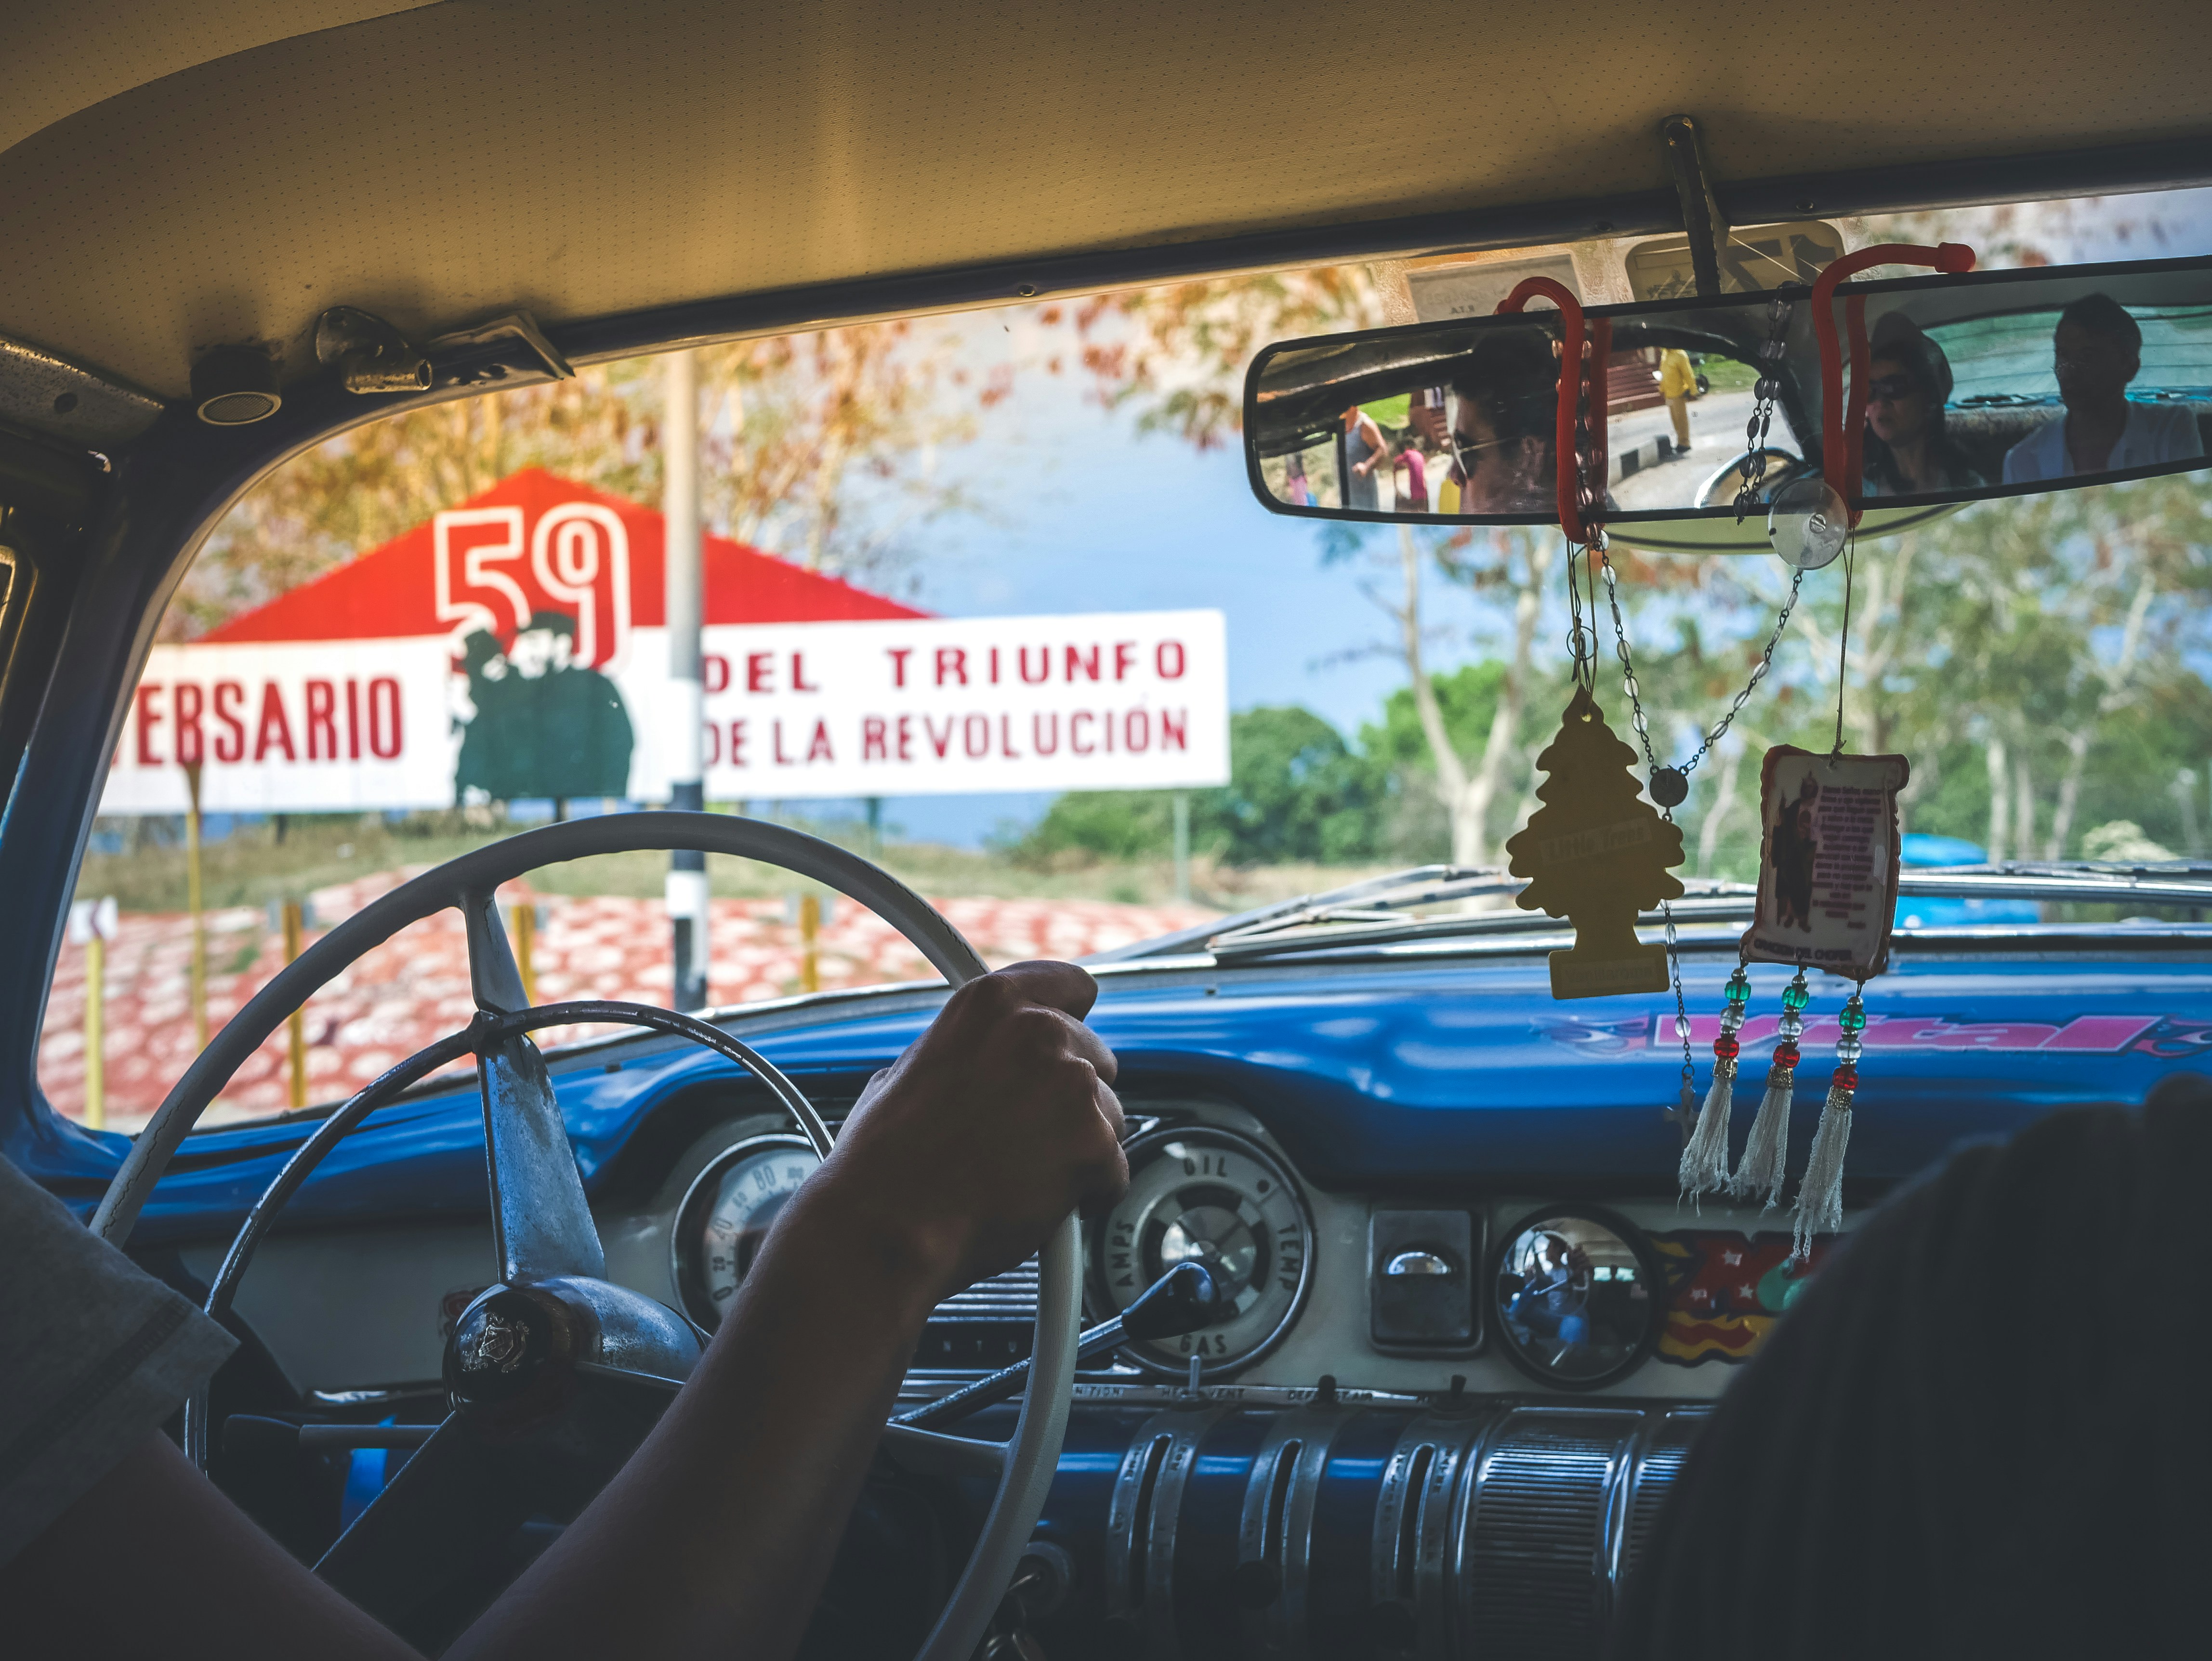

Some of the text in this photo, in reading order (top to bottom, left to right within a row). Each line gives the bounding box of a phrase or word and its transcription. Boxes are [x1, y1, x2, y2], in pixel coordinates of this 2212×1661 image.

[434, 502, 632, 675] 59
[704, 641, 1185, 695] DEL TRIUNFO
[111, 678, 404, 769] ERSARIO
[705, 720, 749, 767] DE
[774, 719, 835, 764] LA
[1183, 1156, 1228, 1177] OIL
[1112, 1220, 1135, 1288] AMPS
[1277, 1222, 1303, 1293] TEMP
[1179, 1333, 1228, 1356] GAS
[1075, 1386, 1121, 1397] NITION
